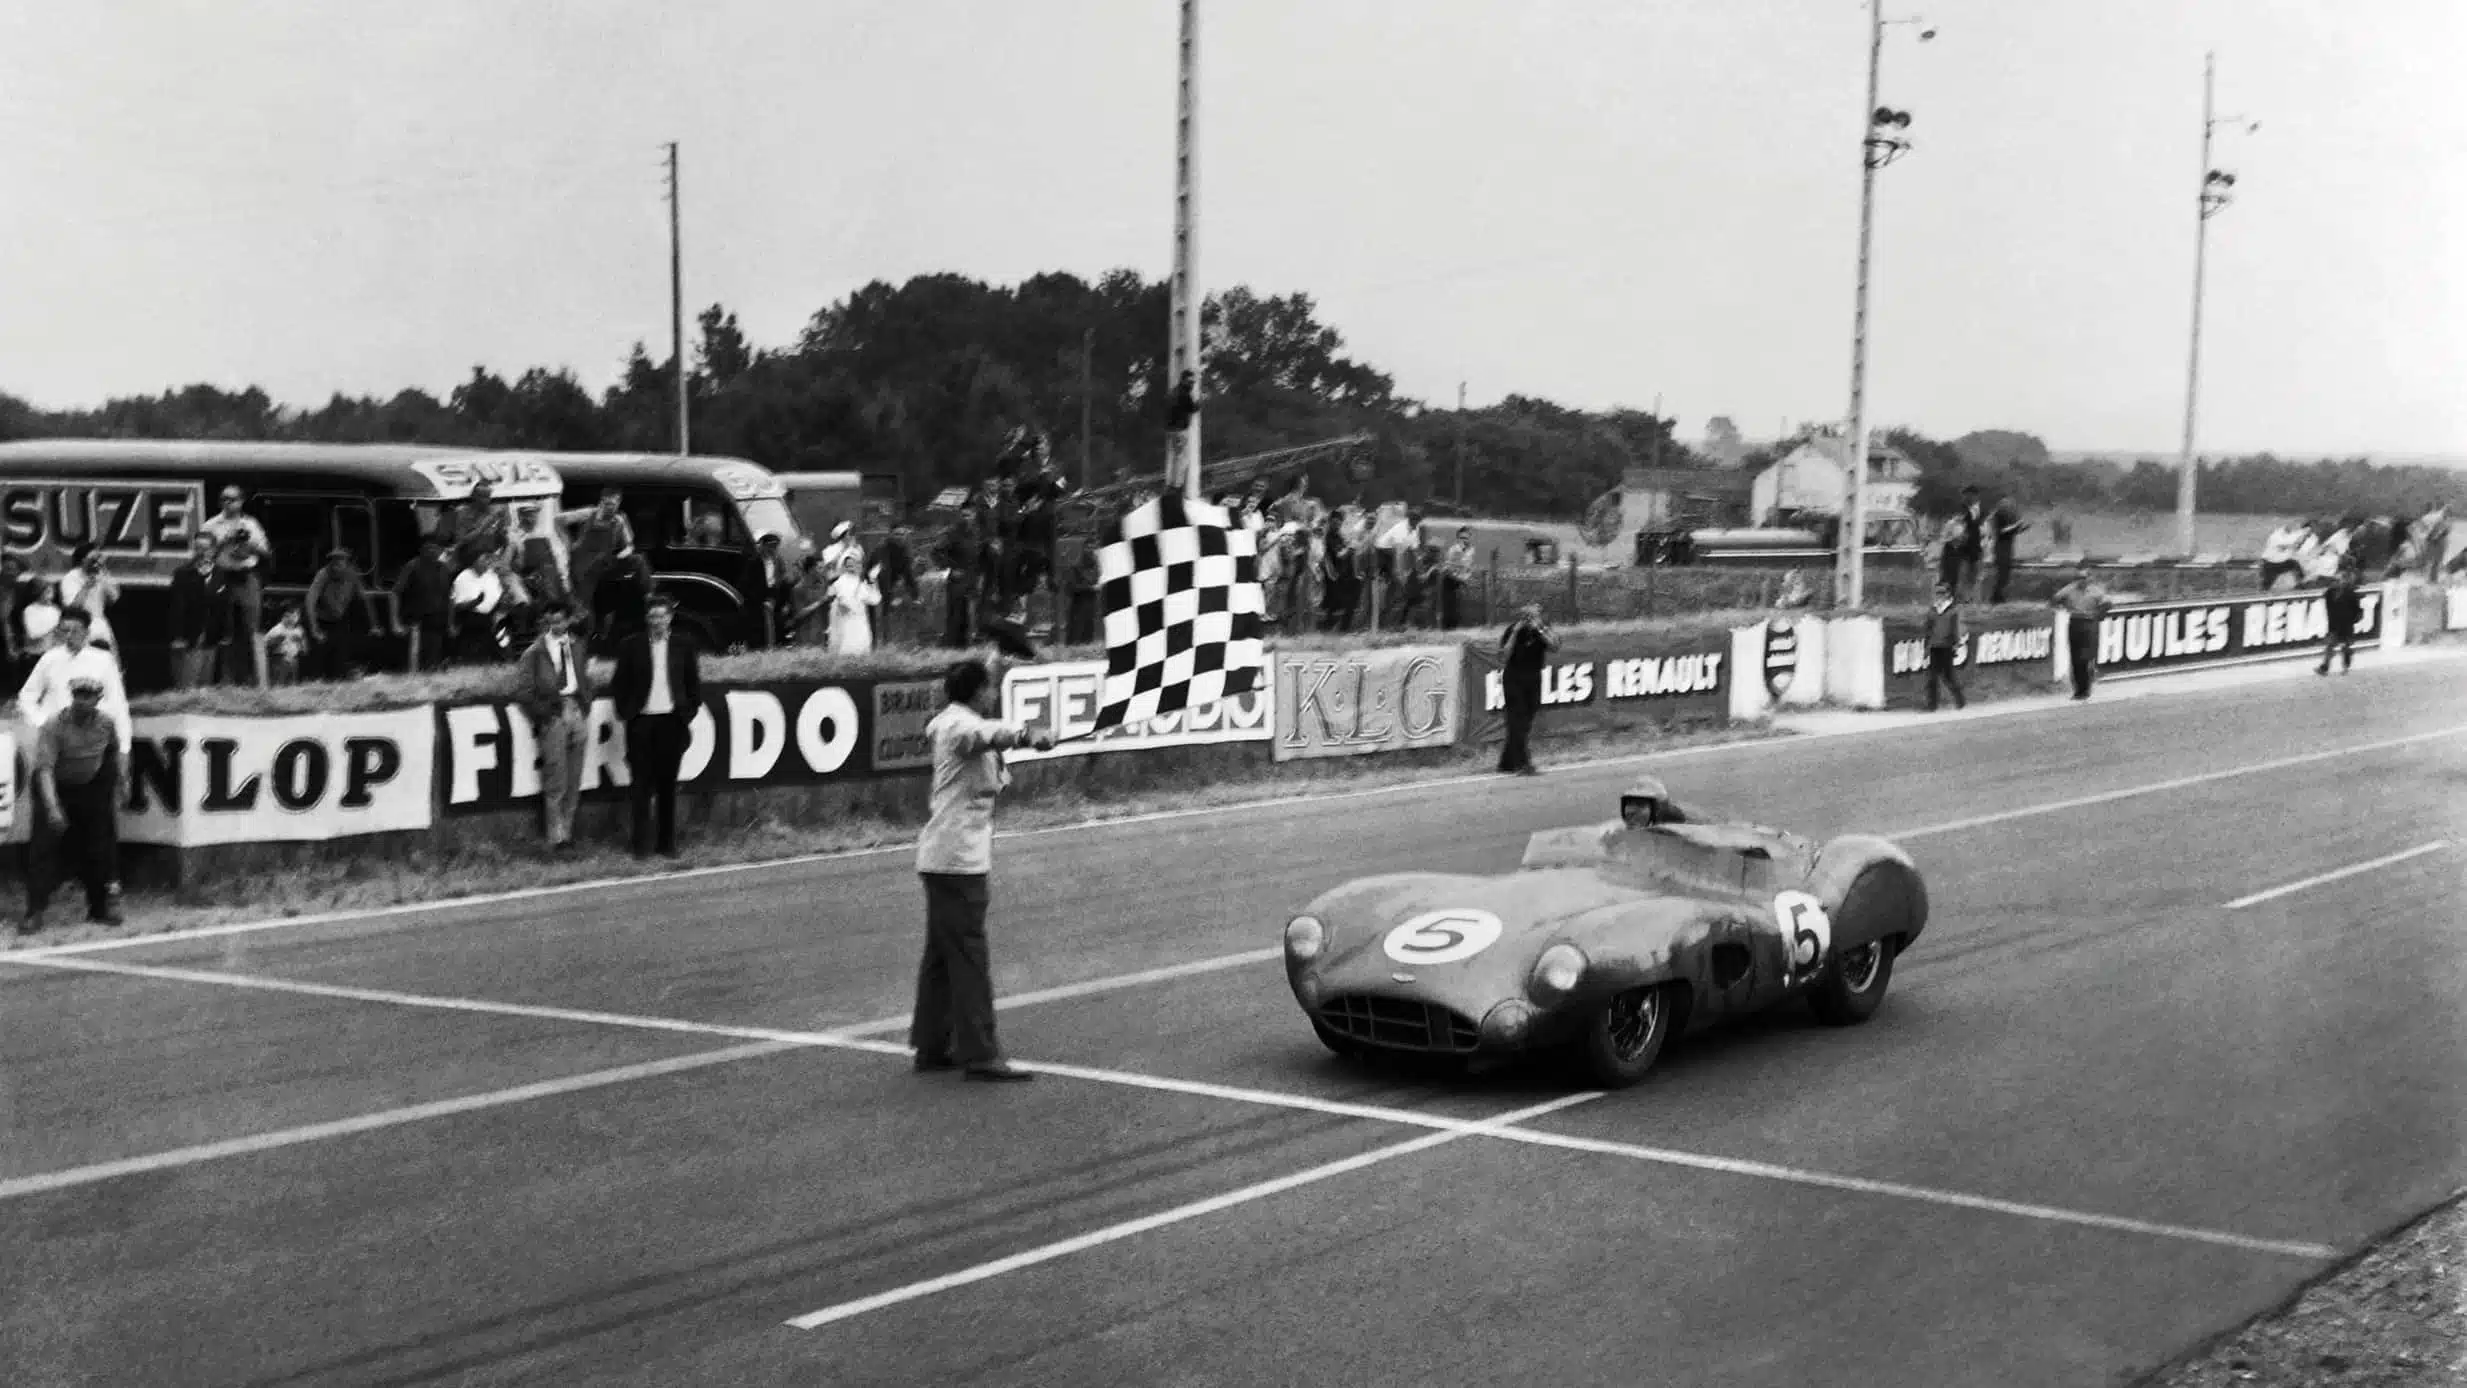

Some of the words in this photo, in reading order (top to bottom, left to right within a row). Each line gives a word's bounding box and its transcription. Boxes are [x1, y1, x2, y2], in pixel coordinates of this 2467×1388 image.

[2, 488, 195, 558] SUZE
[2098, 606, 2231, 665] HUILES
[2243, 593, 2381, 648] RENAT
[1485, 662, 1593, 711] HLES
[1606, 652, 1722, 698] RENAULT
[1401, 916, 1479, 952] 5
[1787, 903, 1821, 982] 5
